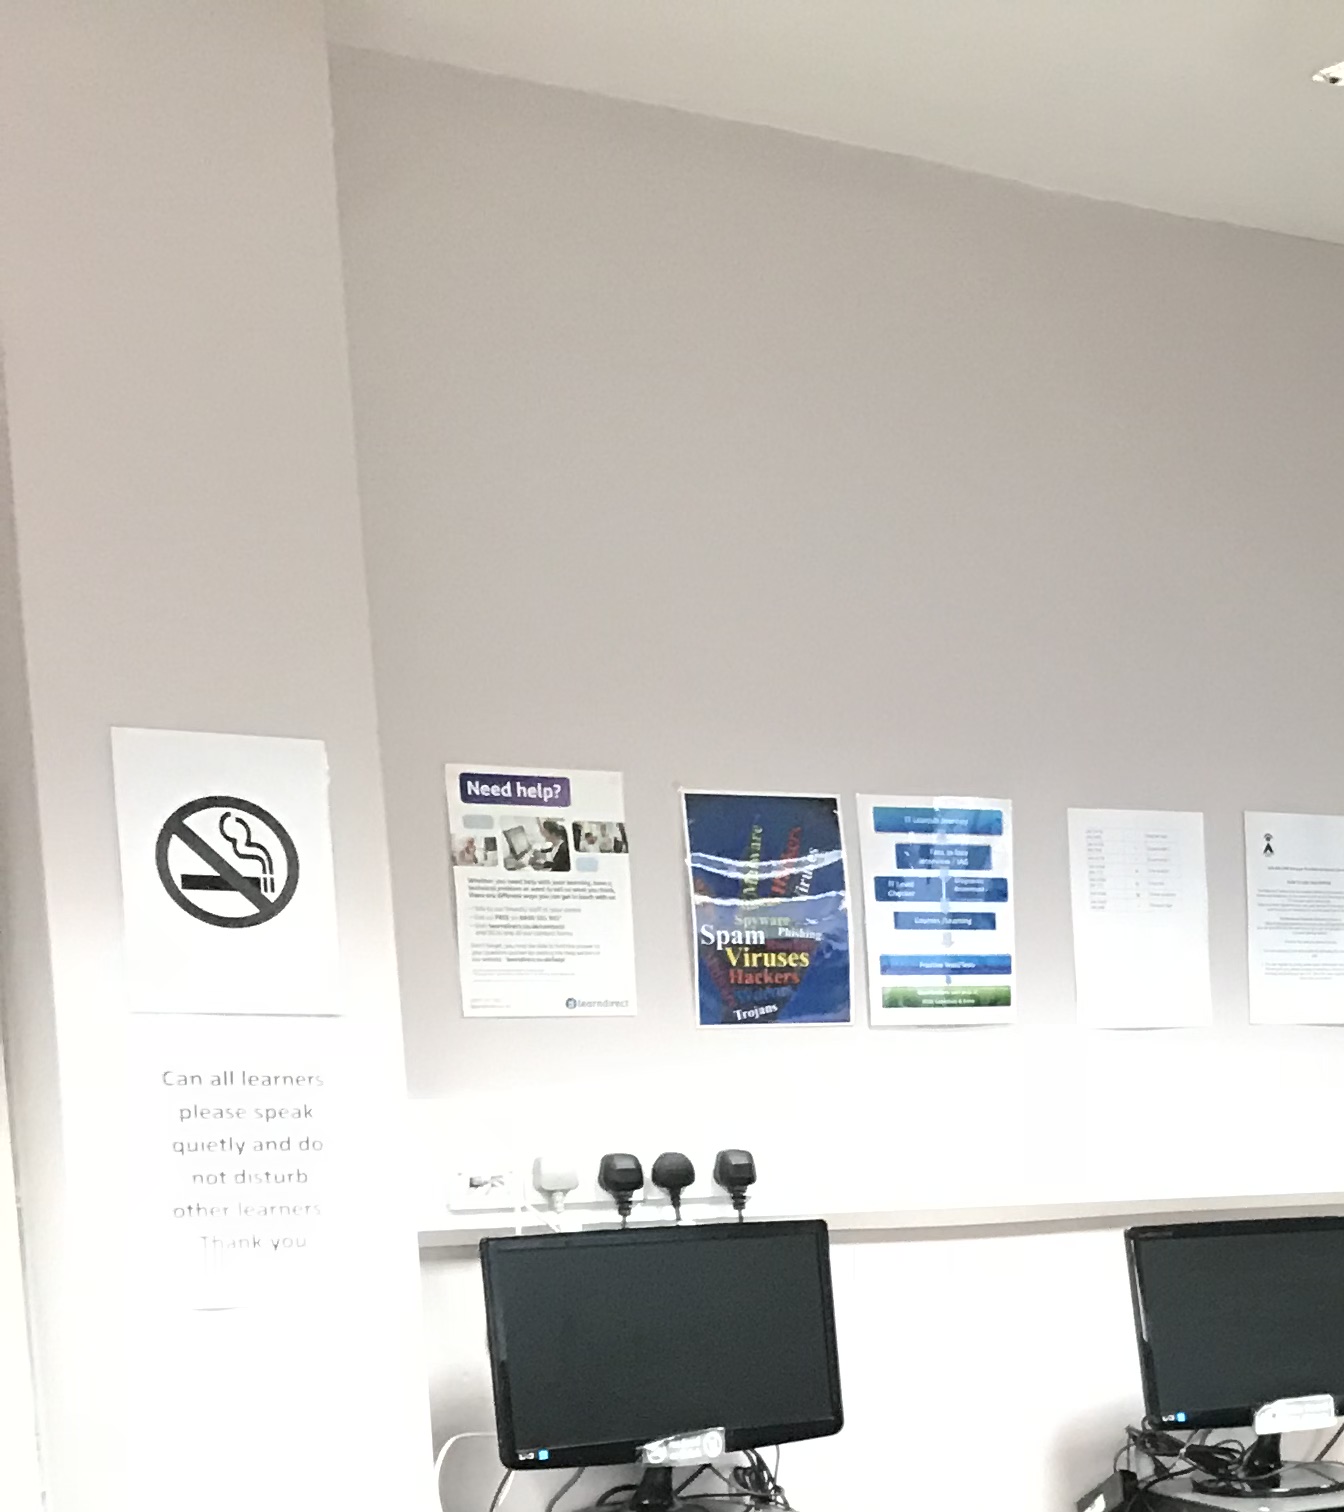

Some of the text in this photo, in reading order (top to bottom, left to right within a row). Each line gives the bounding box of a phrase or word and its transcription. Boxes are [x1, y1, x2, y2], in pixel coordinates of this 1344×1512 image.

[466, 780, 562, 802] Need help?
[700, 924, 766, 950] Spam
[777, 927, 822, 941] Phishing
[724, 946, 811, 968] Viruses
[728, 968, 801, 984] Hackers
[732, 1003, 779, 1021] Trojans
[162, 1070, 325, 1087] Can all learners
[179, 1104, 314, 1122] please speak
[171, 1136, 324, 1155] quietly and do
[192, 1169, 308, 1185] not disturb
[172, 1202, 230, 1218] other
[200, 1234, 307, 1251] Thank you
